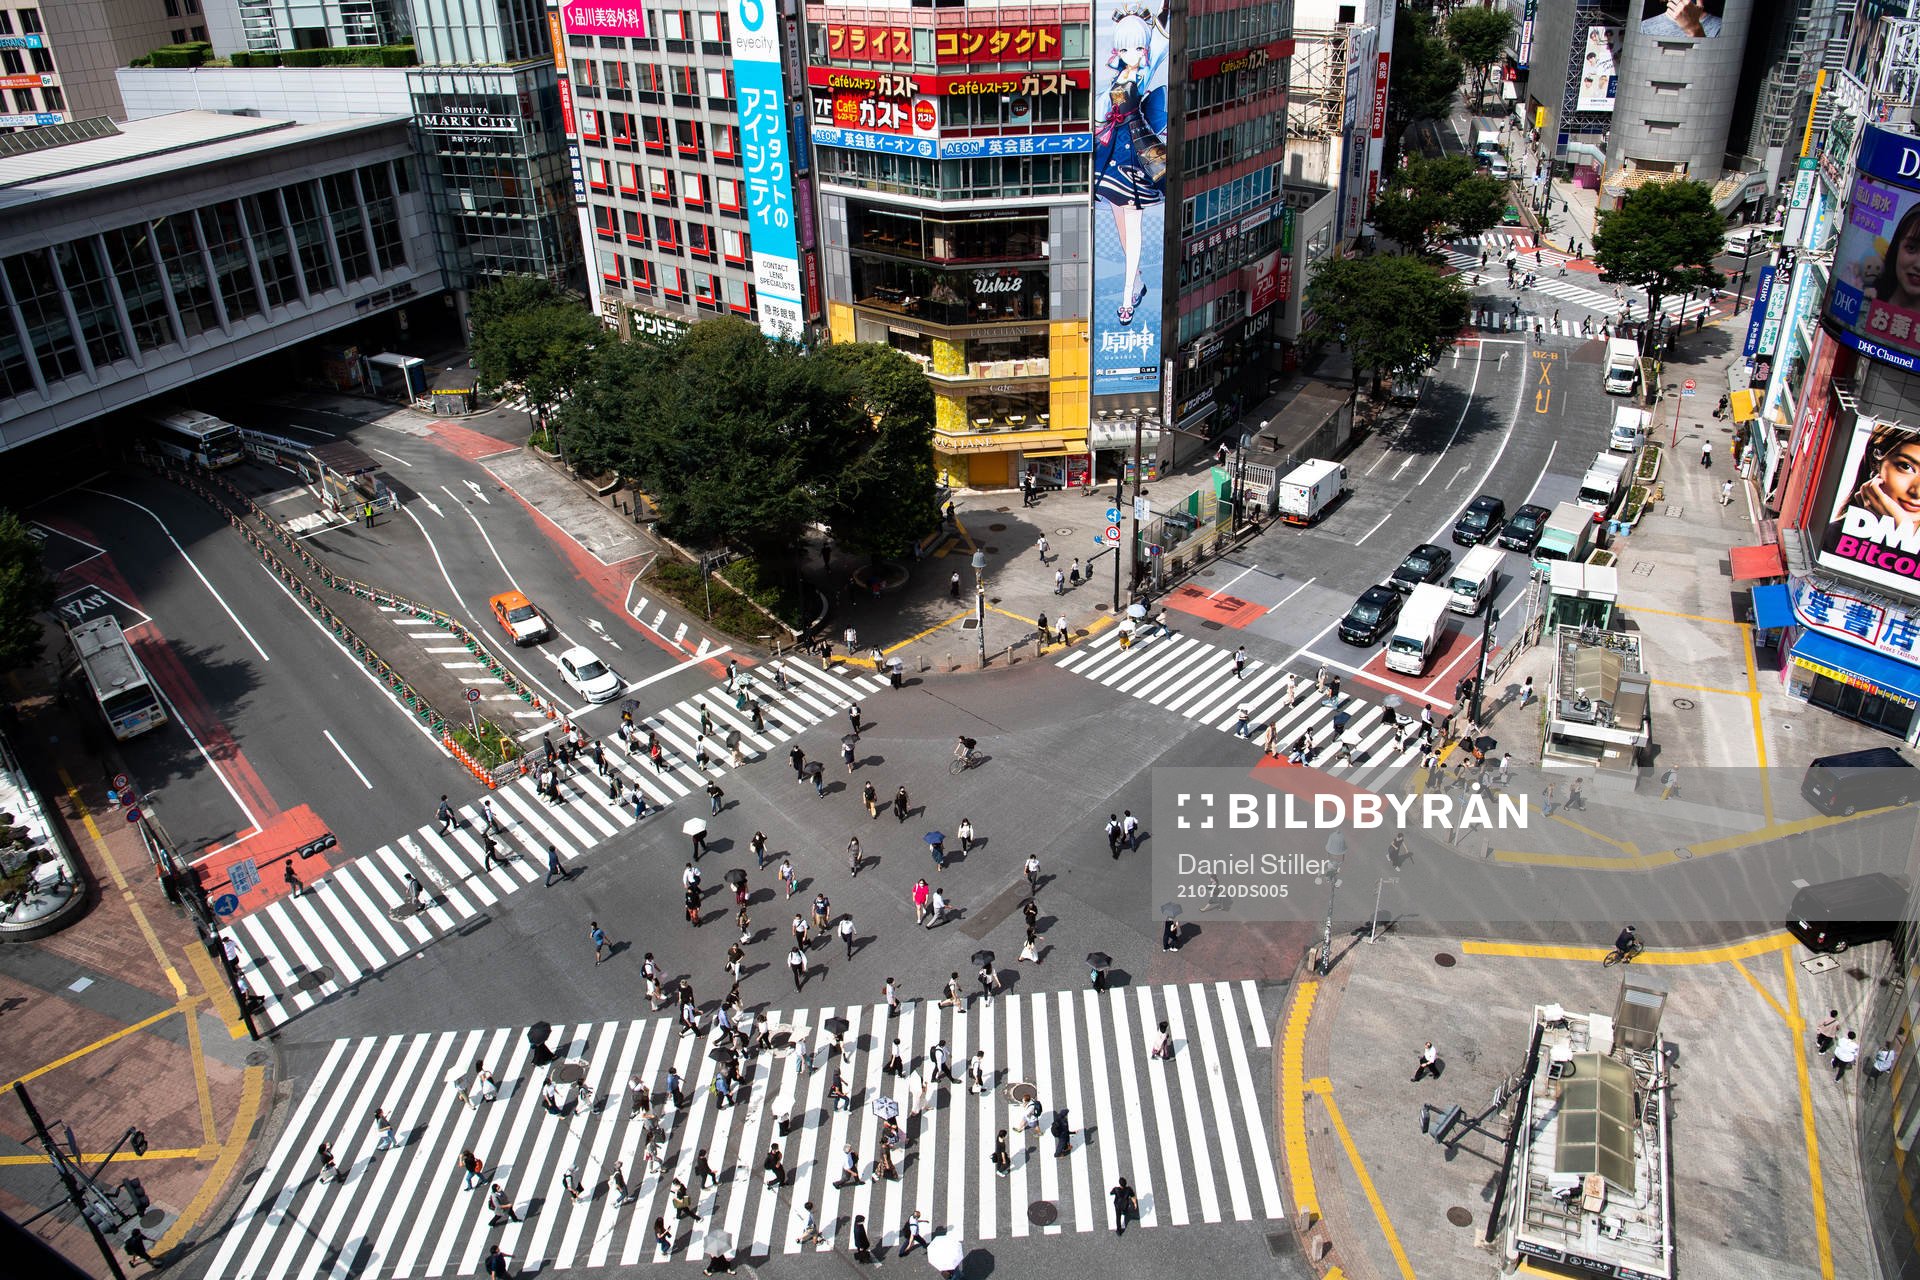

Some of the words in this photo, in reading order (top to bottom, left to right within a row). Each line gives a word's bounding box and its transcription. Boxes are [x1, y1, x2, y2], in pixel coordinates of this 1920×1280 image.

[574, 8, 639, 29] 品川美容外科
[736, 36, 773, 51] eyecity
[829, 28, 911, 55] プライス
[938, 28, 1057, 56] コンタクト
[828, 74, 876, 91] Caféレストラン
[878, 74, 919, 98] ガスト
[949, 80, 1017, 96] Caféレストラン
[1021, 73, 1077, 97] ガスト
[444, 105, 489, 114] SHIBUYA
[814, 98, 833, 116] 7F
[837, 99, 857, 113] Café
[859, 98, 908, 130] ガスト
[1373, 87, 1386, 130] TaxFree
[423, 115, 471, 127] MARK
[477, 116, 516, 128] CITY
[917, 112, 934, 123] ガスト
[815, 130, 838, 142] AEON
[844, 132, 915, 151] 英会話イーオン
[945, 143, 980, 155] AEON
[988, 136, 1090, 155] 英会話イーオン
[741, 87, 770, 227] アイシティ
[763, 89, 789, 230] コンタクトの
[1273, 201, 1284, 218] 4F
[762, 260, 789, 272] CONTACT
[769, 271, 784, 280] LENS
[759, 276, 796, 291] SPECIALISTS
[972, 276, 1023, 294] Ushi8
[1257, 274, 1274, 297] アコム
[1759, 274, 1772, 302] MIZUHO
[1834, 289, 1857, 314] DHC
[969, 326, 1029, 338] L'OCCITANE
[1244, 310, 1270, 341] LUSH
[1747, 322, 1760, 351] みずほ銀行
[1099, 320, 1155, 363] 原神
[1858, 340, 1877, 355] DHC
[1876, 348, 1914, 369] Channel
[1841, 504, 1920, 556] DM
